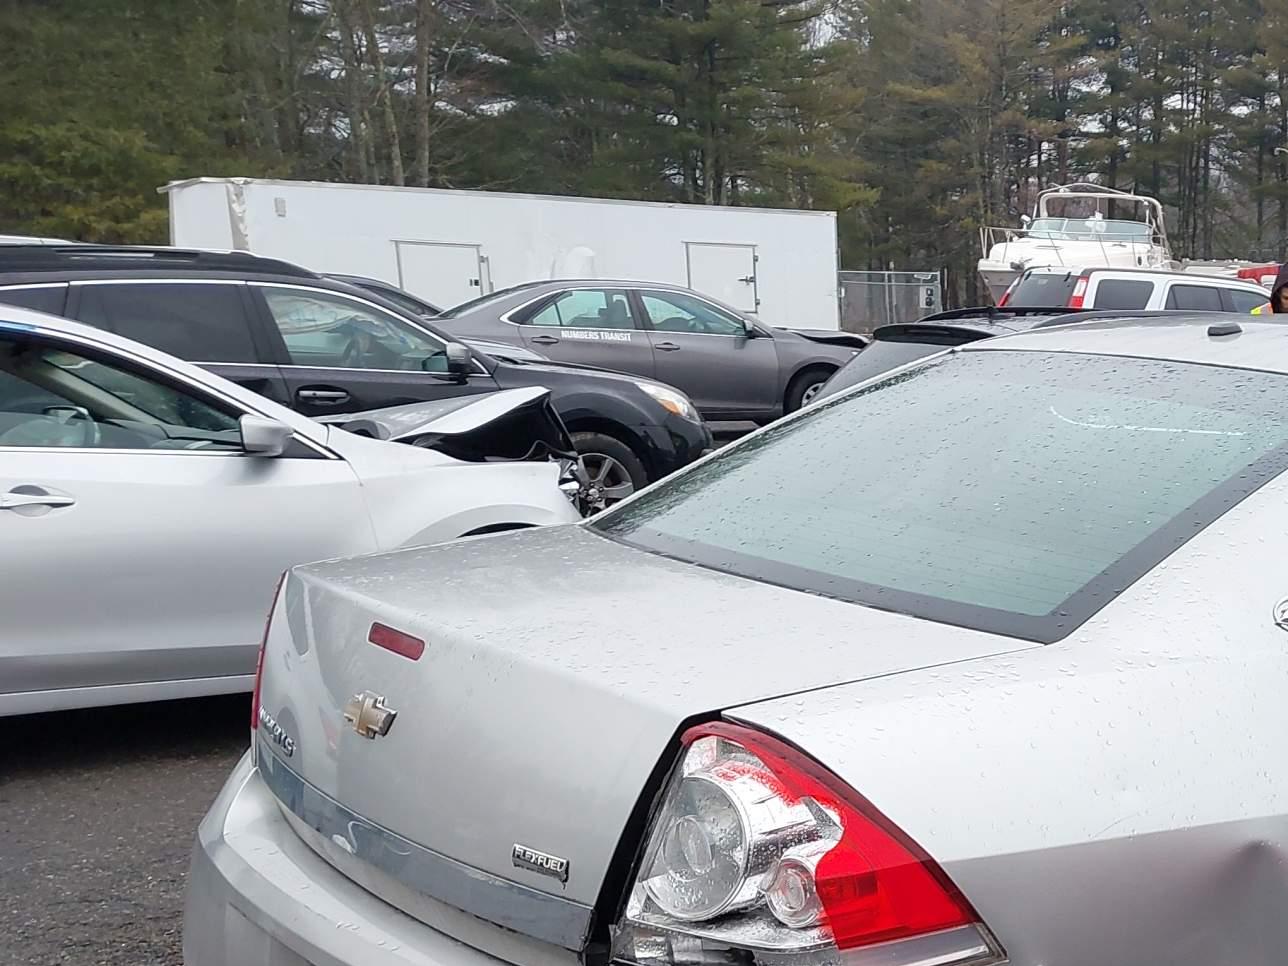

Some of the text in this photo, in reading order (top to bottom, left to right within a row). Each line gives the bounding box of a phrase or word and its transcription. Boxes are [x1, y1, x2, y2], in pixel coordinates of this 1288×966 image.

[561, 330, 631, 341] NUMBERS TRANSIT
[515, 847, 564, 872] FLEXFUEL
